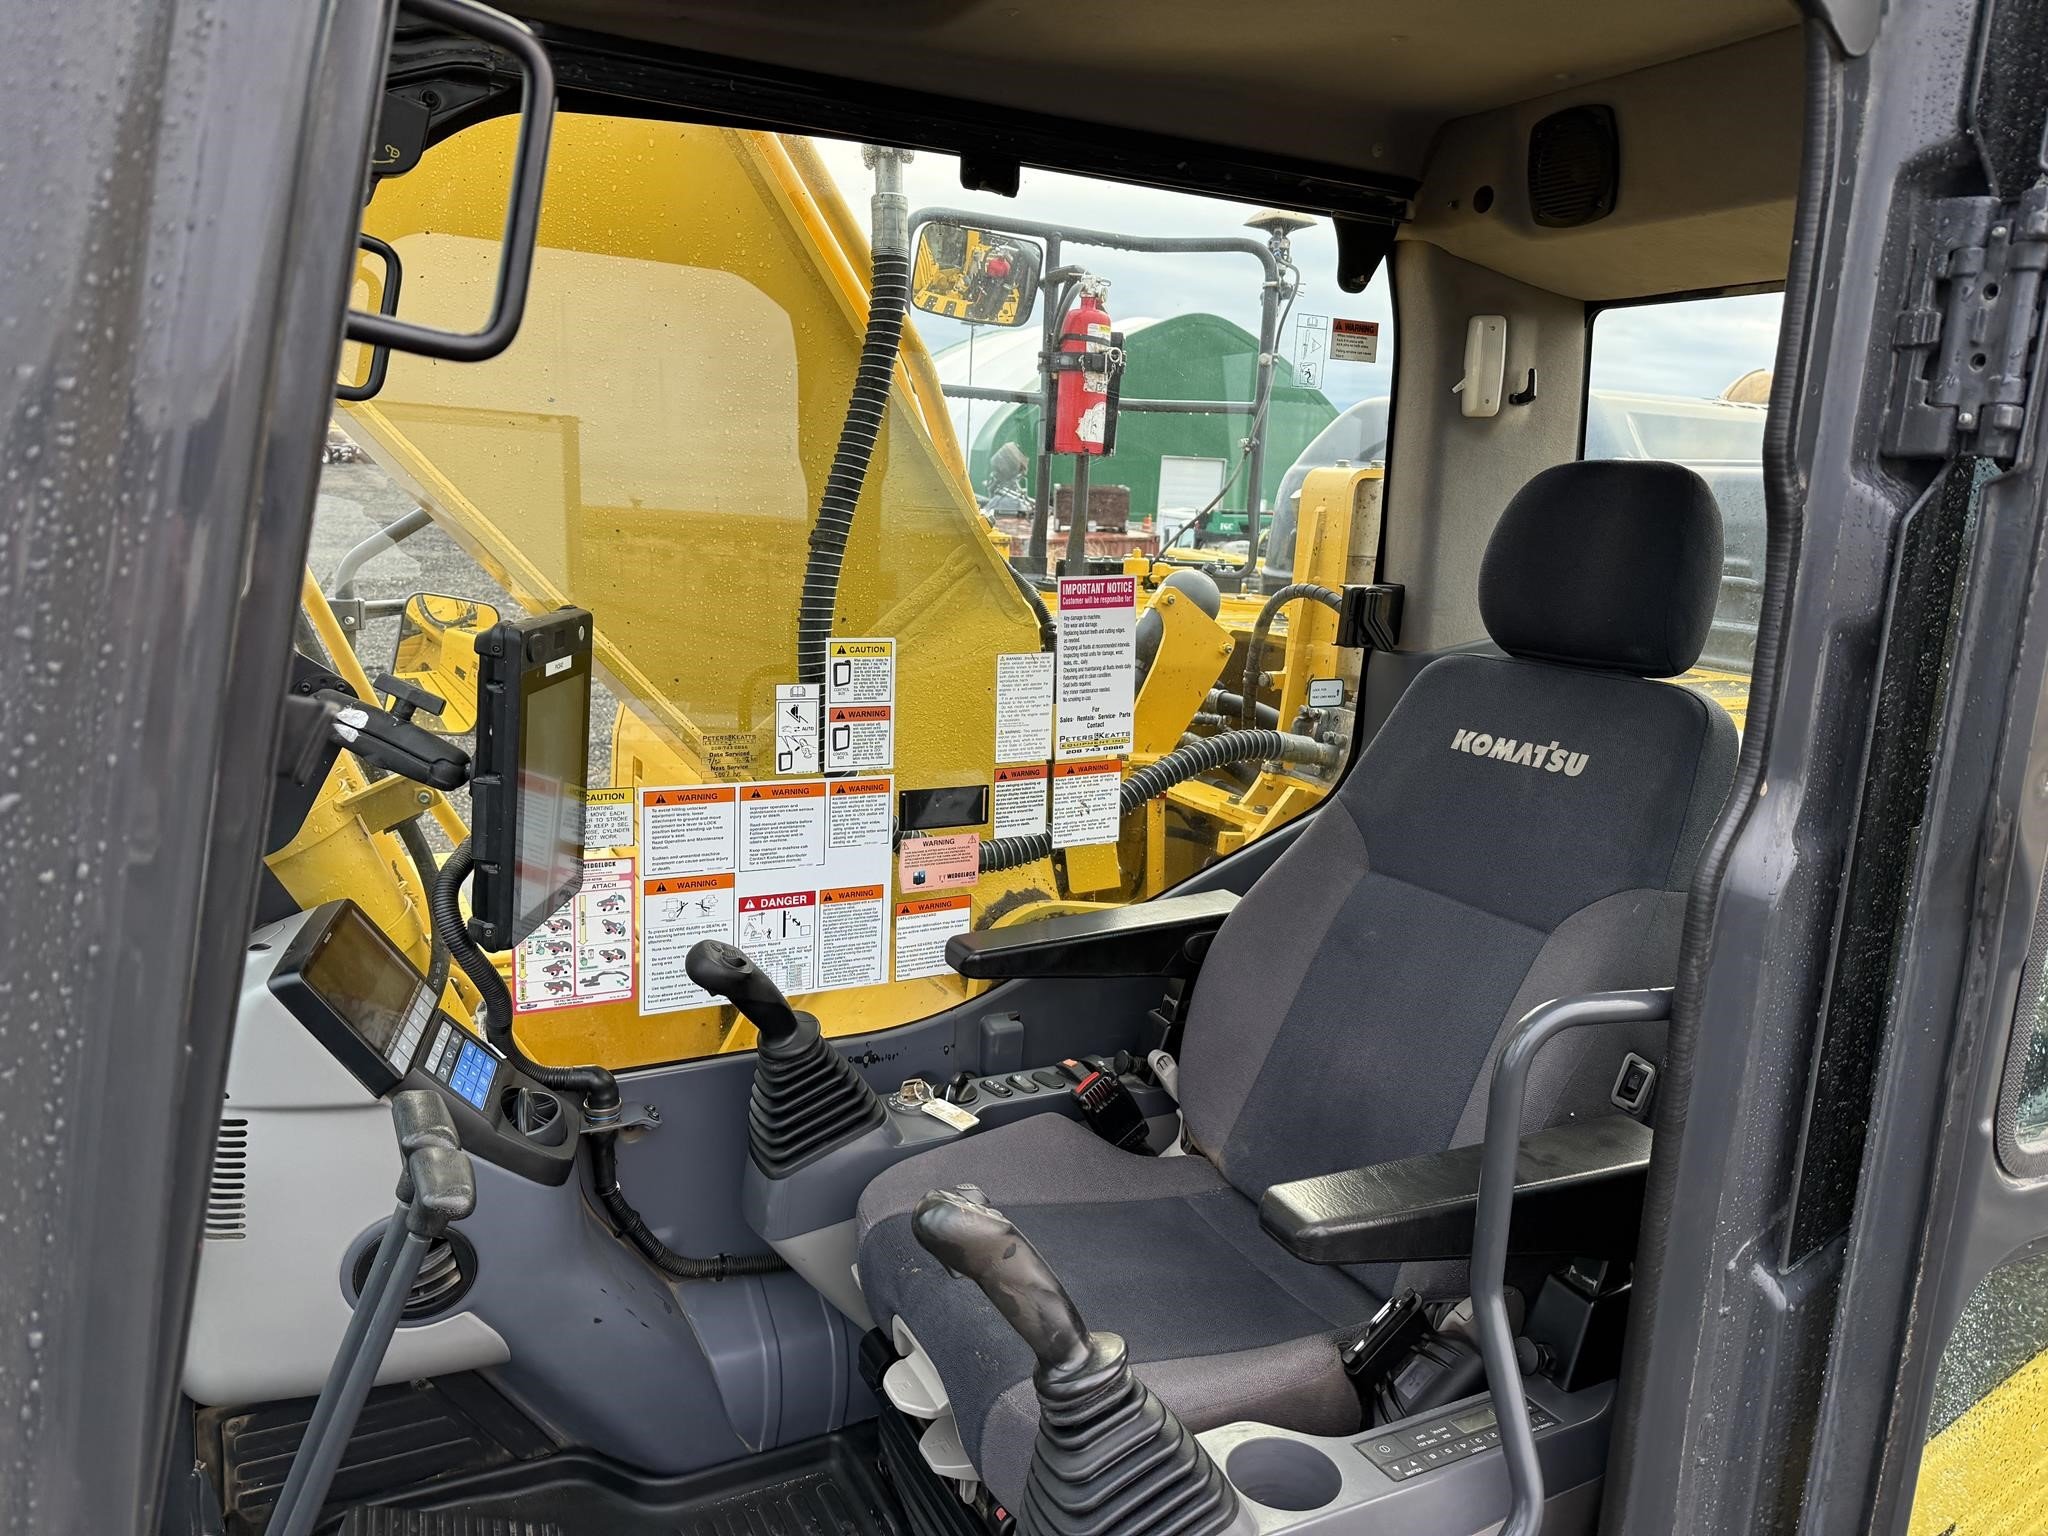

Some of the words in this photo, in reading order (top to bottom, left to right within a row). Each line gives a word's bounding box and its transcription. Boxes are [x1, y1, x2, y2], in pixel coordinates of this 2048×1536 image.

[1345, 322, 1374, 333] WARNING
[1062, 583, 1104, 595] IMPORTANT
[1107, 581, 1132, 593] NOTICE
[1450, 728, 1590, 776] KOMATSU
[849, 784, 884, 792] WARNING
[676, 793, 718, 801] WARNING
[923, 839, 955, 847] WARNING
[947, 871, 976, 879] WEDGELOCK
[677, 880, 717, 889] WARNING
[839, 890, 874, 898] WARNING
[761, 895, 807, 908] DANGER
[918, 901, 952, 911] WARNING
